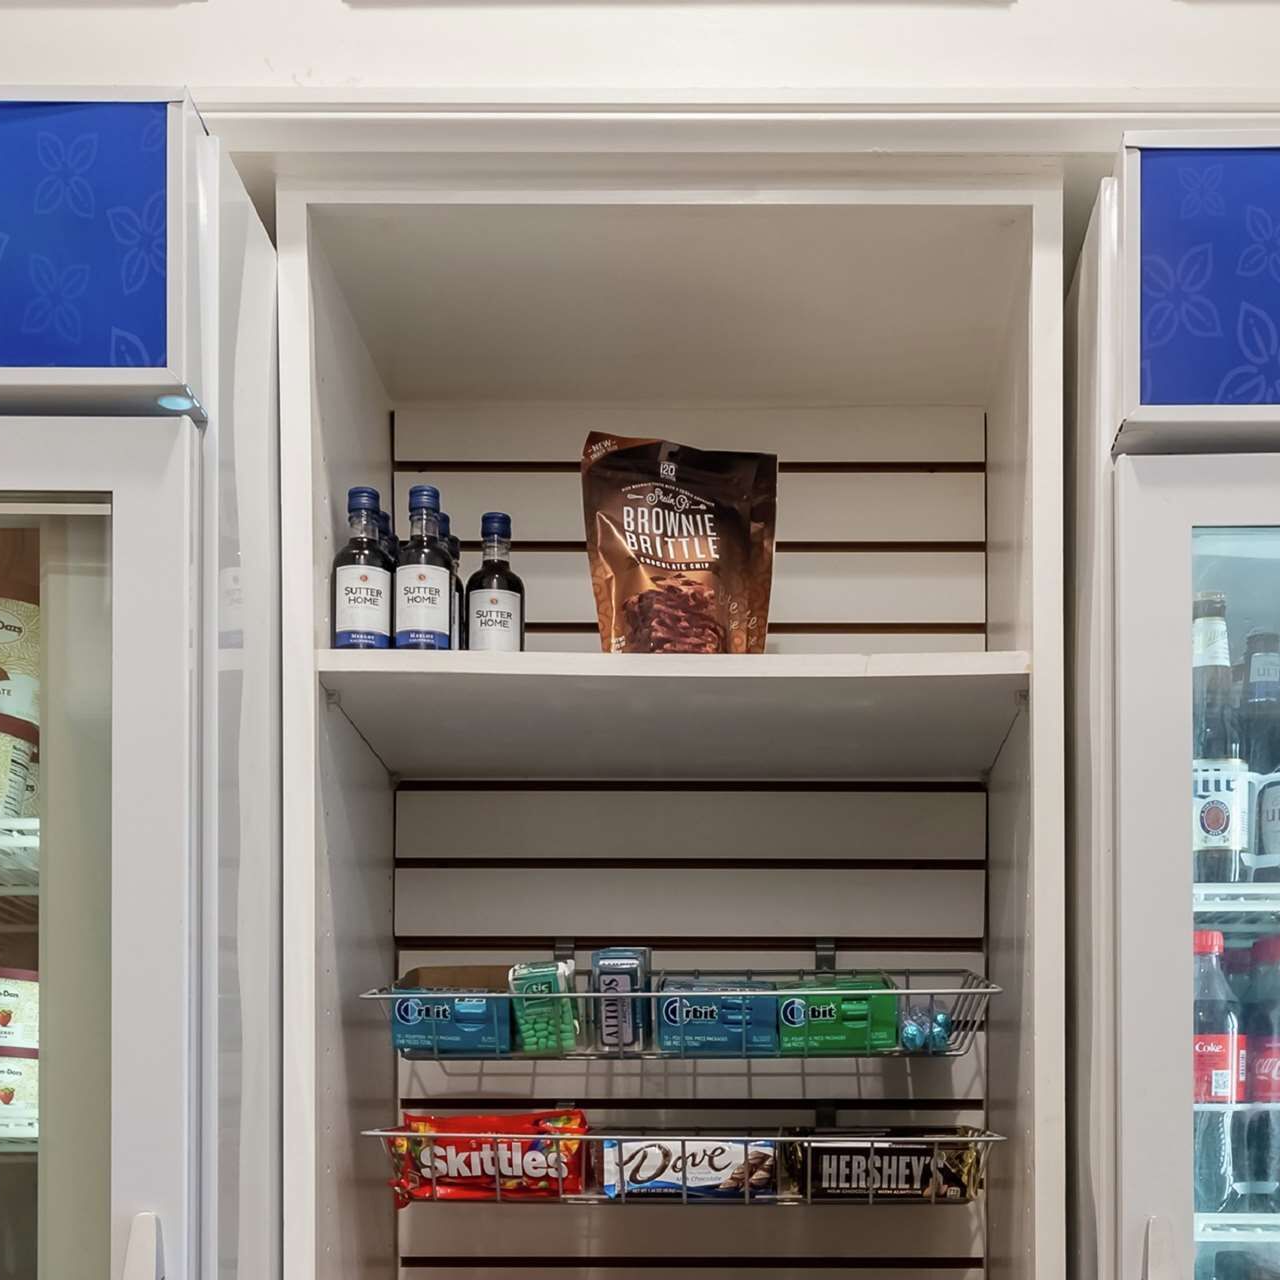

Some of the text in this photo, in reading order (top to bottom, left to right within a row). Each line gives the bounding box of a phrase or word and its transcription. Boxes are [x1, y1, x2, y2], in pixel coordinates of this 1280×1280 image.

[659, 463, 675, 476] 120
[623, 506, 717, 538] BROWNIE
[626, 531, 720, 560] BRITTLE
[640, 556, 710, 571] CHOCOLATE CHIP
[345, 586, 382, 598] SUTTER
[403, 586, 440, 597] SUTTER
[348, 596, 379, 606] HOME
[407, 596, 437, 605] HOME
[475, 610, 513, 620] SUTTER
[479, 619, 510, 629] HOME
[531, 983, 549, 993] tic
[663, 997, 719, 1027] Orbit
[781, 998, 838, 1028] Obit
[1195, 1041, 1224, 1053] Coke
[420, 1142, 569, 1179] Skittles
[616, 1143, 733, 1185] Dove
[822, 1154, 944, 1190] HERSHEY'S
